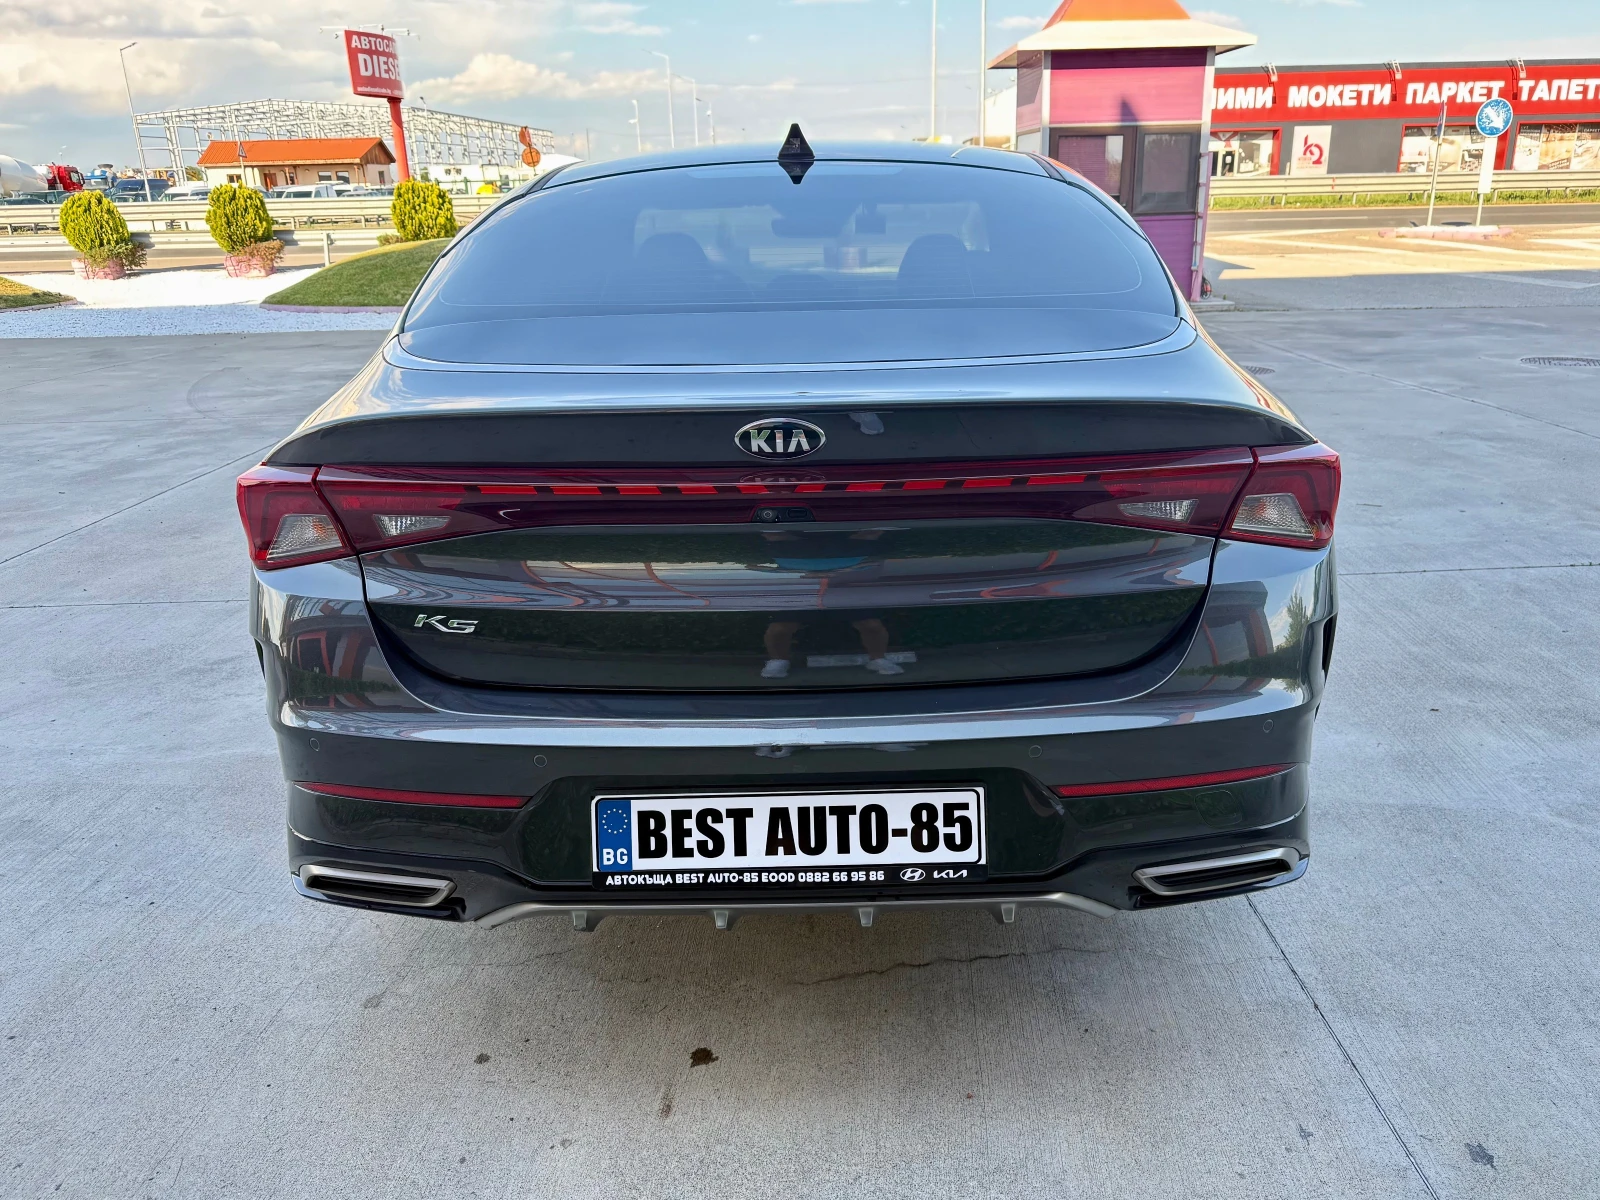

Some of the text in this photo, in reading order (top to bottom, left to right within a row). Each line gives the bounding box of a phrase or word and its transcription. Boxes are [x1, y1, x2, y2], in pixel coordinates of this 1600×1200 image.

[1287, 83, 1392, 108] МОКЕТИ
[1405, 80, 1505, 104] ПАРКЕТ
[1518, 78, 1600, 101] ТАПЕТ
[749, 429, 811, 453] KIA
[636, 802, 973, 859] BEST AUTO-85
[602, 848, 628, 865] BG
[675, 874, 705, 884] BEST
[708, 873, 759, 883] AUTO-85
[798, 872, 830, 882] 0882
[833, 872, 848, 881] 66
[851, 871, 866, 881] 95
[869, 871, 885, 881] 86
